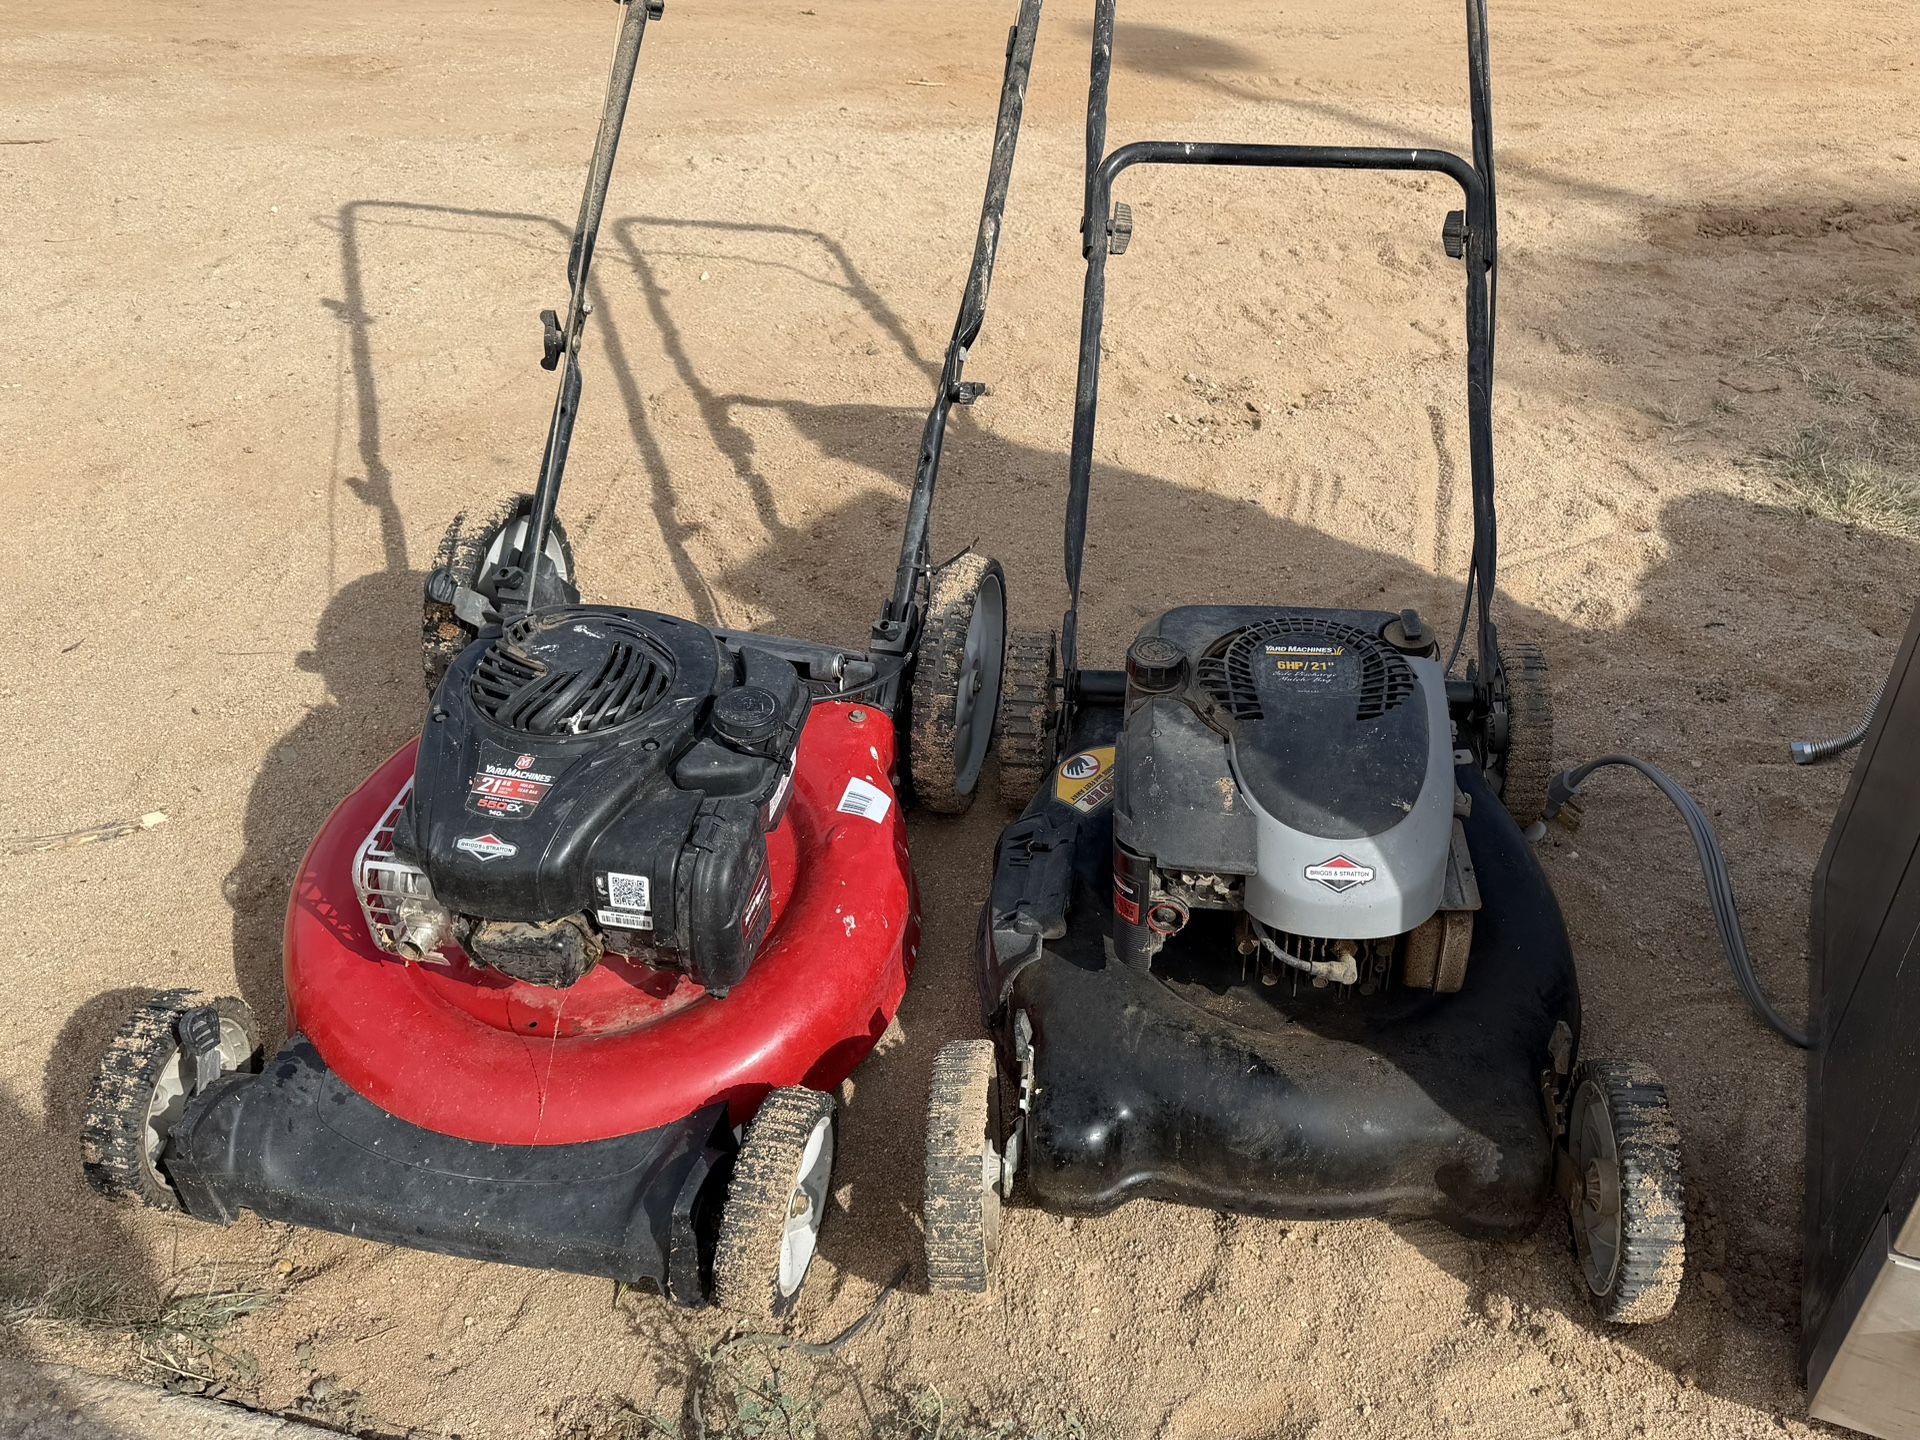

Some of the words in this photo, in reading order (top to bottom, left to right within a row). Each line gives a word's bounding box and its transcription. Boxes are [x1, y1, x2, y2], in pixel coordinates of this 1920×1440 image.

[1287, 645, 1333, 653] MACHINES
[485, 764, 507, 775] YARD
[506, 768, 552, 782] MACHINES
[477, 777, 501, 793] 21
[1070, 789, 1085, 801] AWAY
[486, 845, 513, 853] STRATTON
